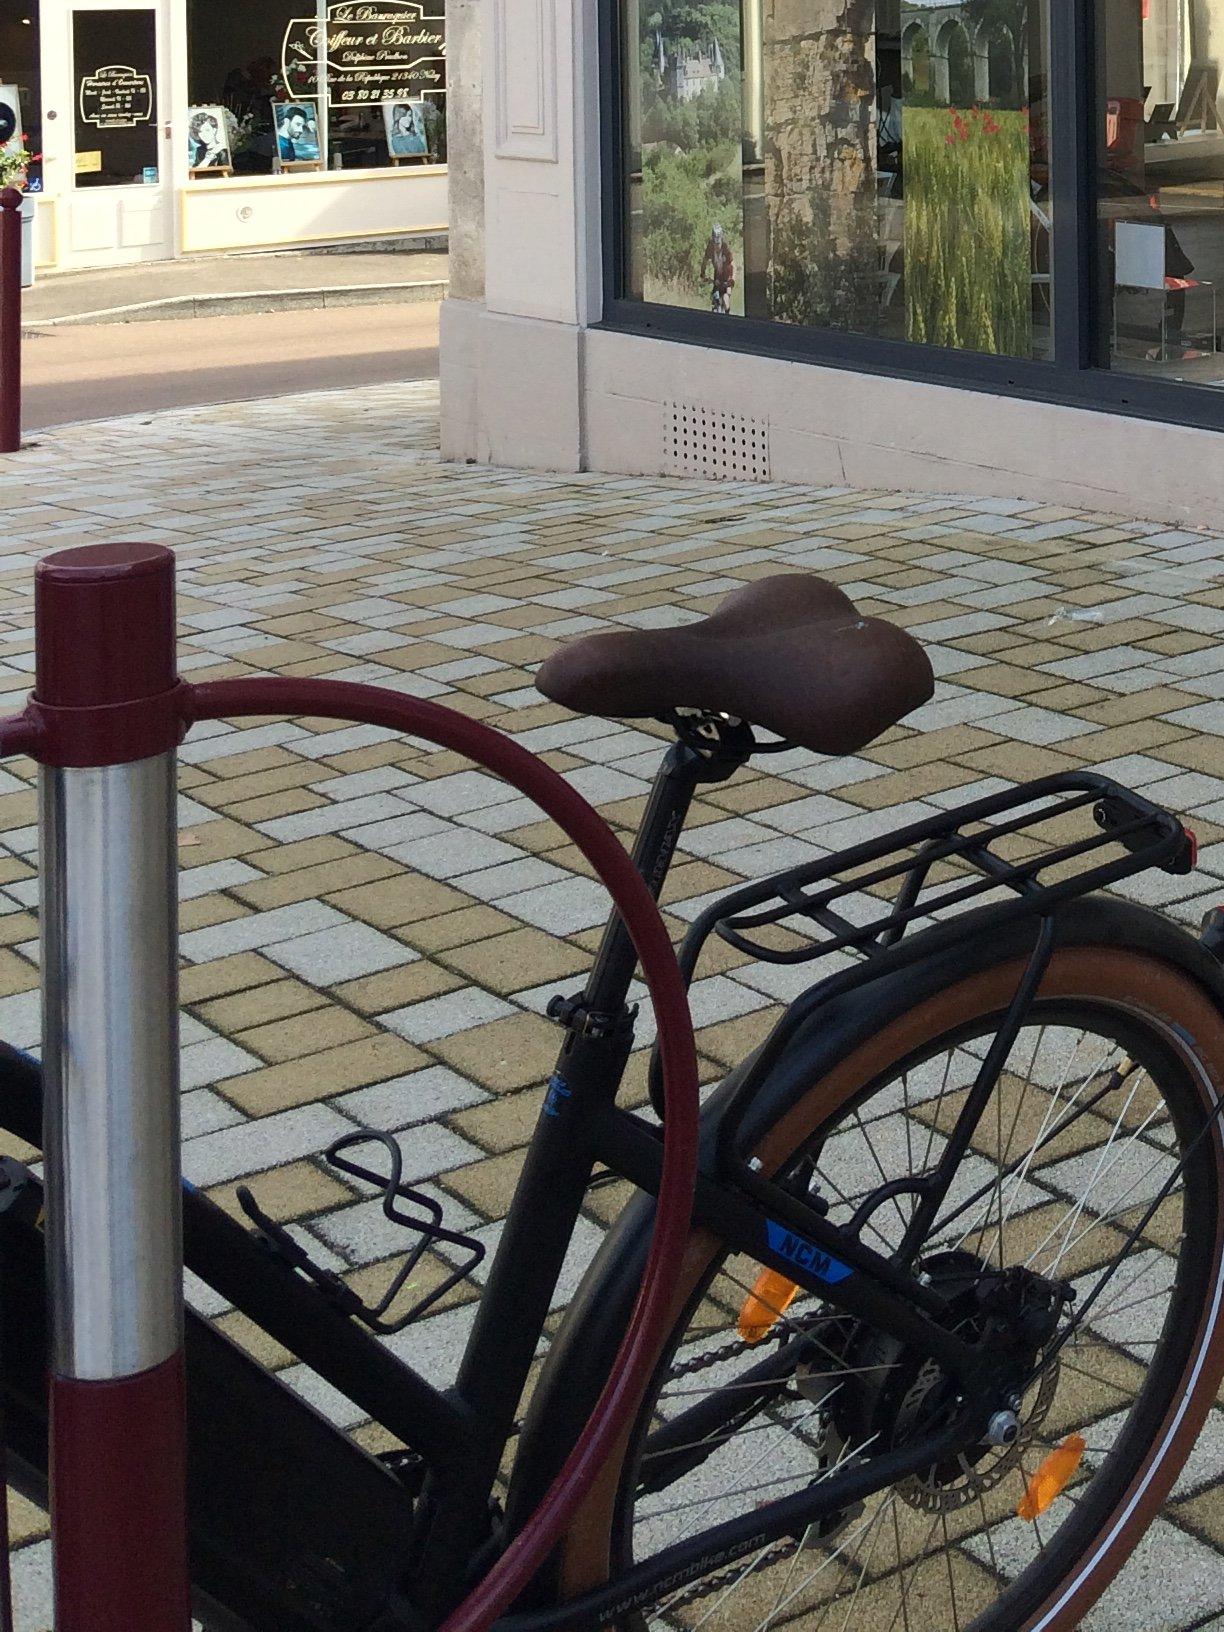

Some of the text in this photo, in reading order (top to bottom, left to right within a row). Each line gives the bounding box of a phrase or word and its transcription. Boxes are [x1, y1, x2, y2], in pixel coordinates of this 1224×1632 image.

[334, 6, 353, 21] Le
[305, 25, 442, 52] Ciffeur et Barbier
[779, 1233, 832, 1274] NCM
